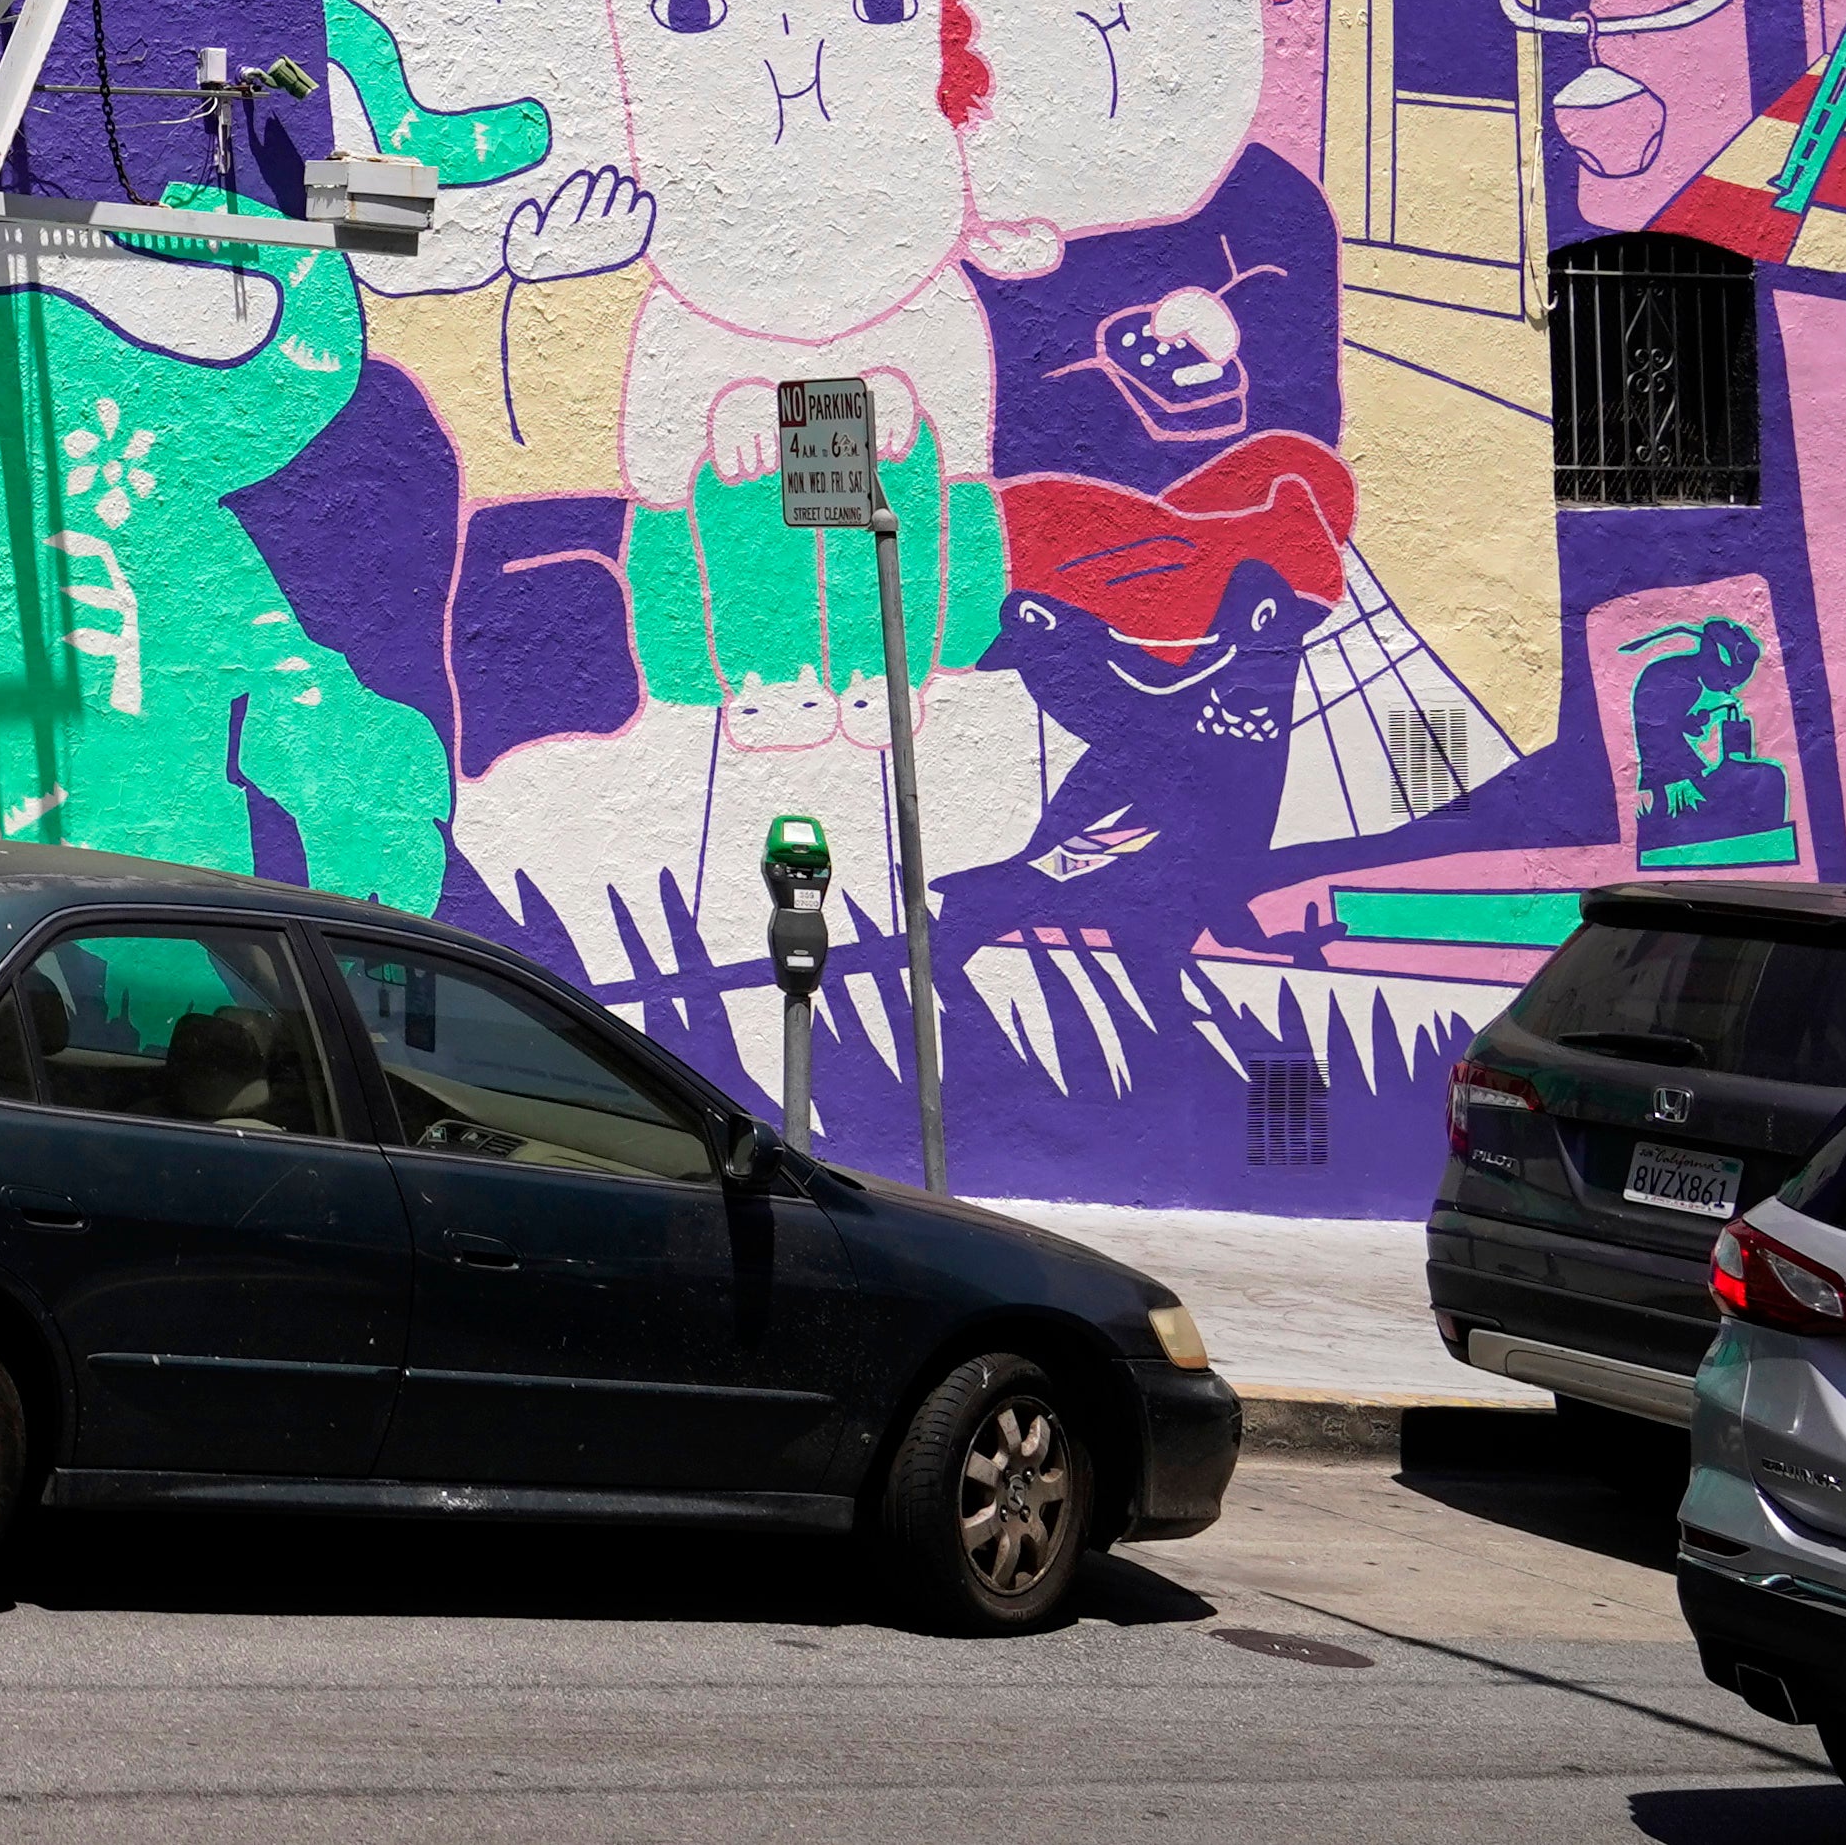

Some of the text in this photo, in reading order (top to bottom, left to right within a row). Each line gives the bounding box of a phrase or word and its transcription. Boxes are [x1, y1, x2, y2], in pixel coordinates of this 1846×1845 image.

[781, 387, 862, 421] NO PARKING
[790, 433, 799, 458] 4
[793, 507, 862, 521] STREET CLEANING
[1472, 1149, 1517, 1167] PILOT
[1655, 1149, 1720, 1172] California
[1633, 1166, 1727, 1208] 8VZX861
